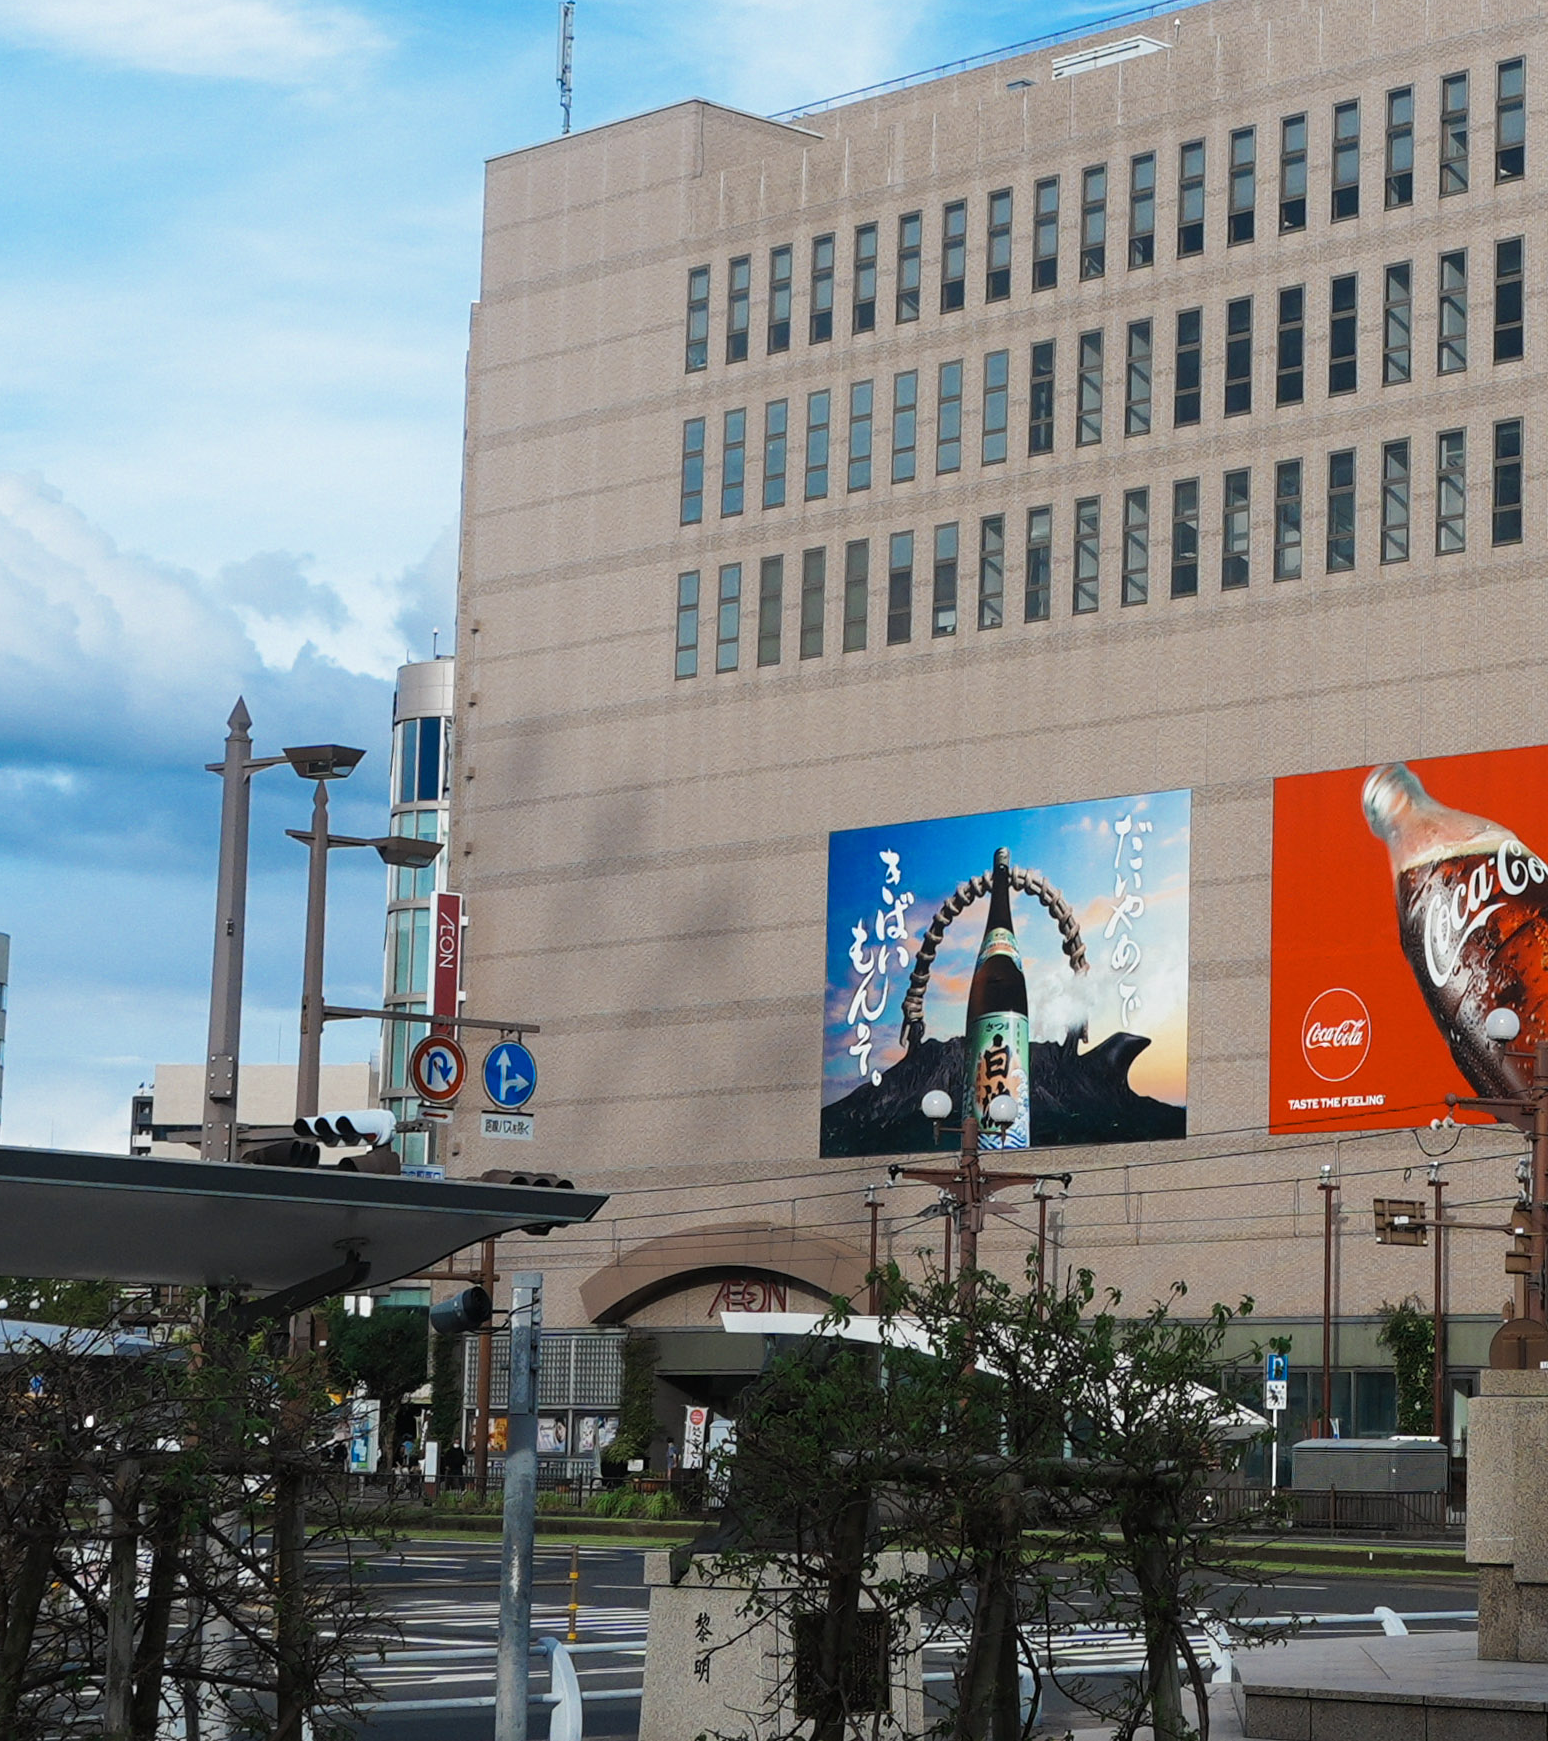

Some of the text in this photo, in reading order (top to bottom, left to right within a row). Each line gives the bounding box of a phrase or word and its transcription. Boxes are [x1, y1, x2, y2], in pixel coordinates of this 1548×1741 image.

[1288, 1094, 1385, 1111] TASTE THE FEELING
[693, 1611, 714, 1685] 黎明
